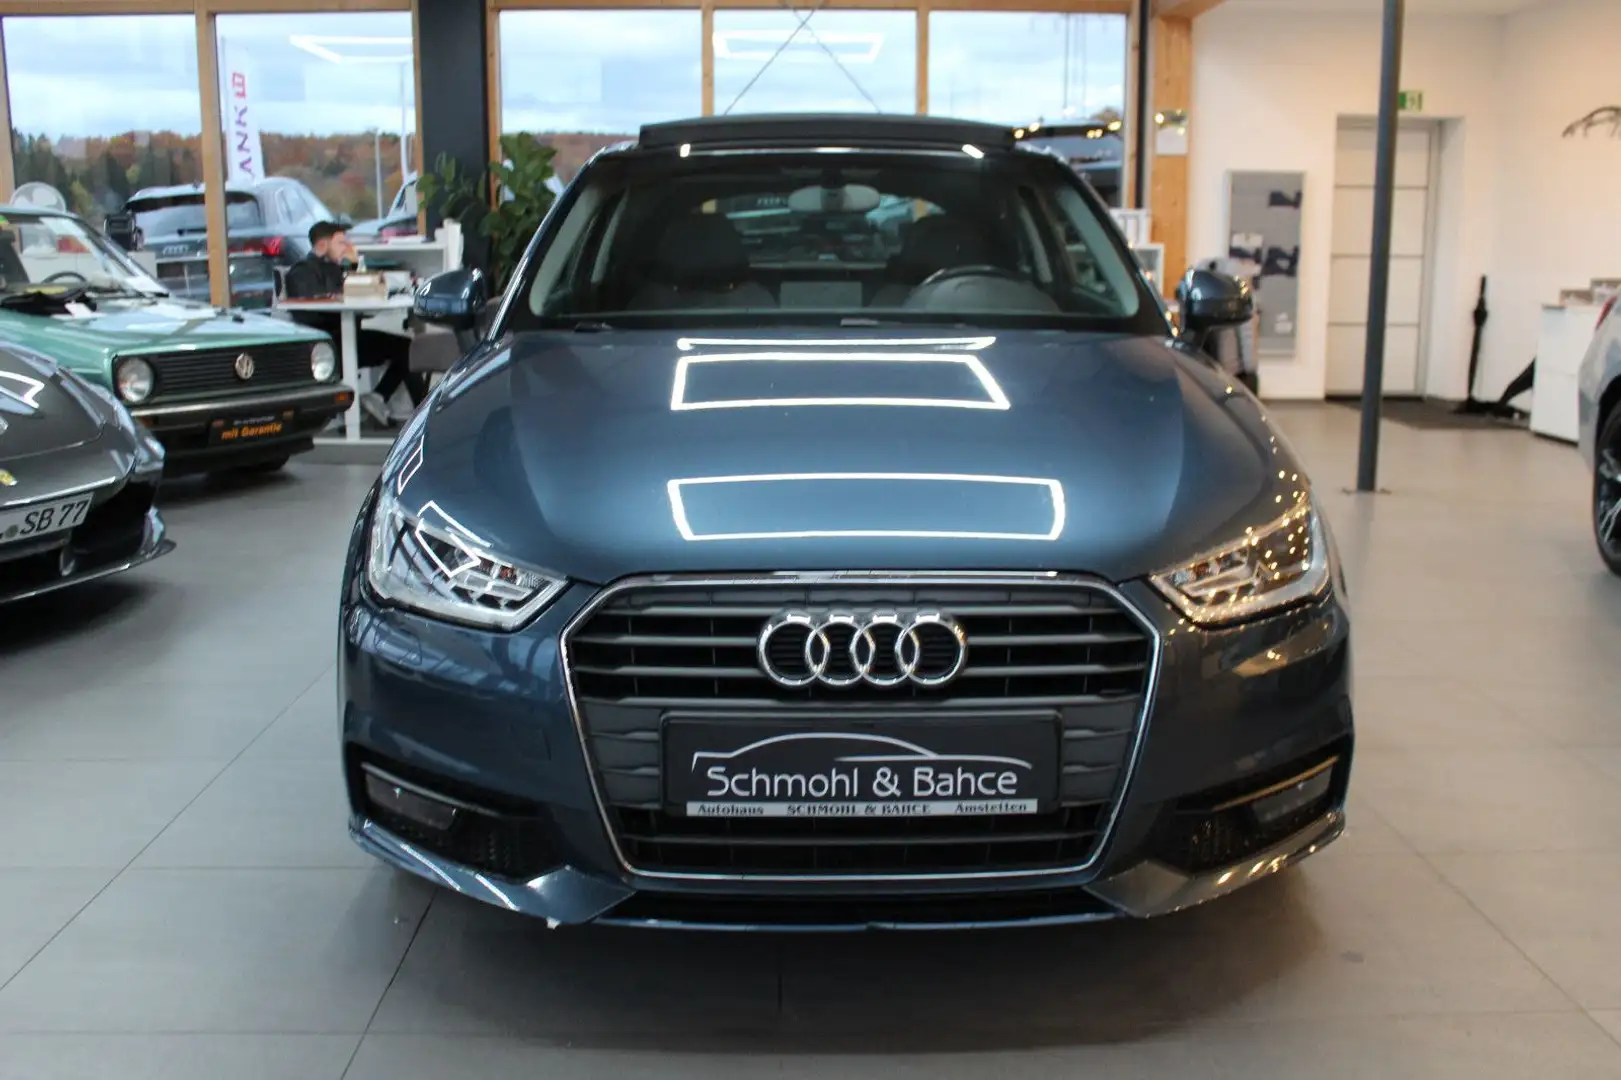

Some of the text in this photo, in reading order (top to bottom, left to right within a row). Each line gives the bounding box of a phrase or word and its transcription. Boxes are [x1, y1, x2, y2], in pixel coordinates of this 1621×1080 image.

[20, 500, 90, 535] SB 77
[706, 766, 1018, 798] Schmohl & Bahce
[698, 804, 764, 816] Autohaus
[787, 804, 859, 817] SCHMOHL
[882, 804, 931, 816] BAHCE
[955, 801, 1027, 814] Amstetten
